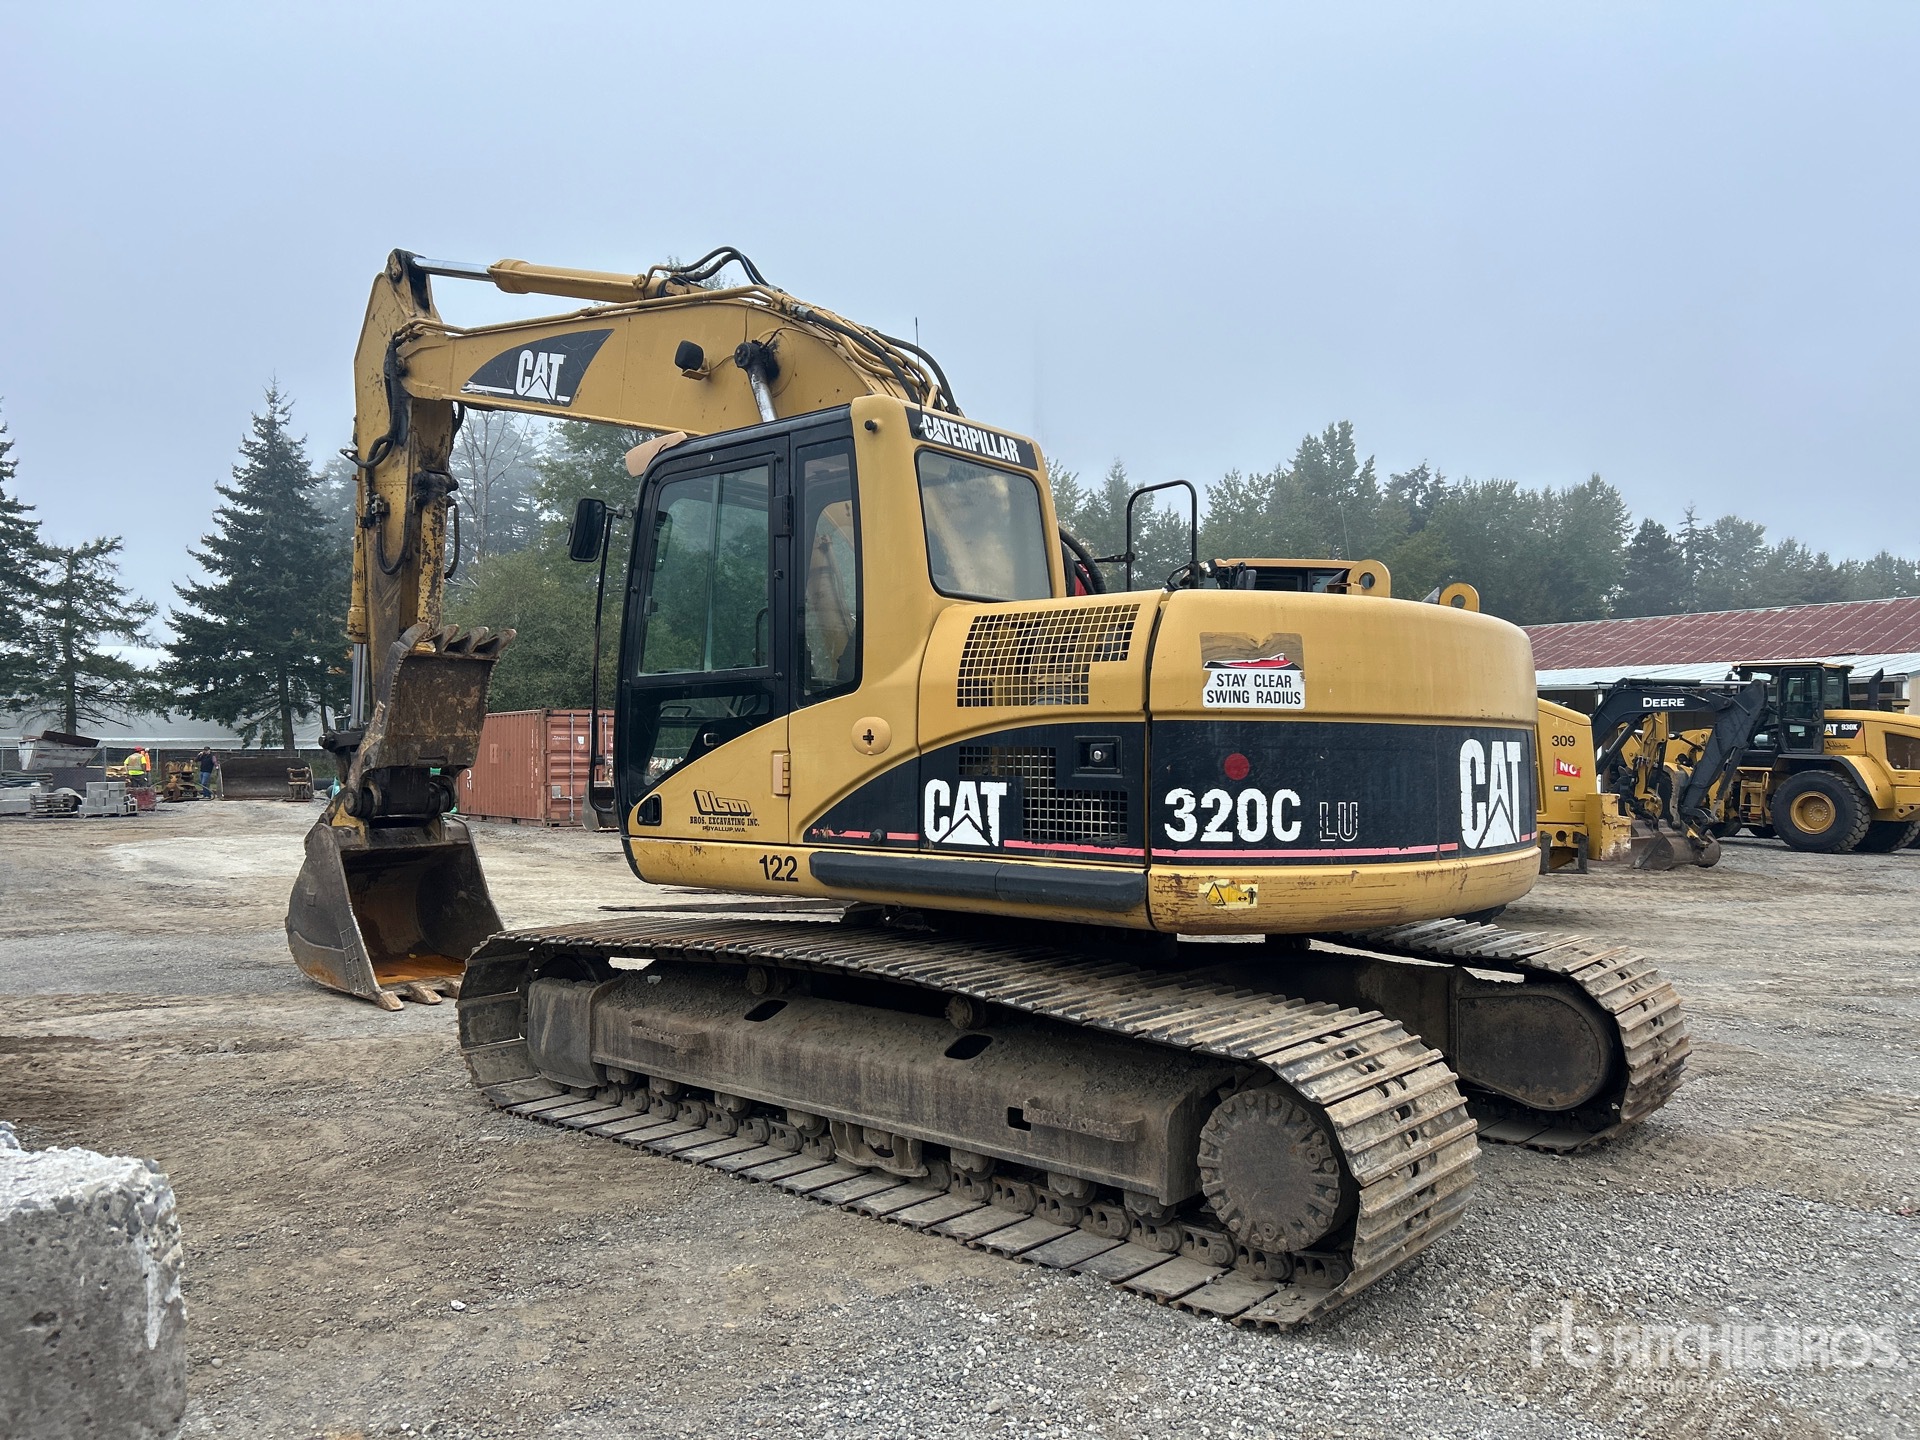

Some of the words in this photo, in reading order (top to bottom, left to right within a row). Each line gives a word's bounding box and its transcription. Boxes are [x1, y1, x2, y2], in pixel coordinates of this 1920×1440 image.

[515, 350, 567, 400] CAT
[920, 414, 1021, 464] CATERPILLAR
[1216, 674, 1247, 687] STAY
[1254, 674, 1292, 688] CLEAR
[1206, 690, 1250, 704] SWING
[1256, 691, 1301, 705] RADIUS
[1642, 697, 1685, 708] DEERE
[1823, 723, 1839, 736] AT
[1551, 735, 1576, 747] 309
[1459, 738, 1522, 849] CAT
[689, 816, 707, 825] BROS.
[708, 817, 745, 826] EXCAVATING
[747, 818, 760, 827] INC.
[924, 779, 1007, 847] CAT
[1164, 787, 1302, 843] 320C
[1319, 801, 1359, 842] LU
[759, 854, 799, 882] 122
